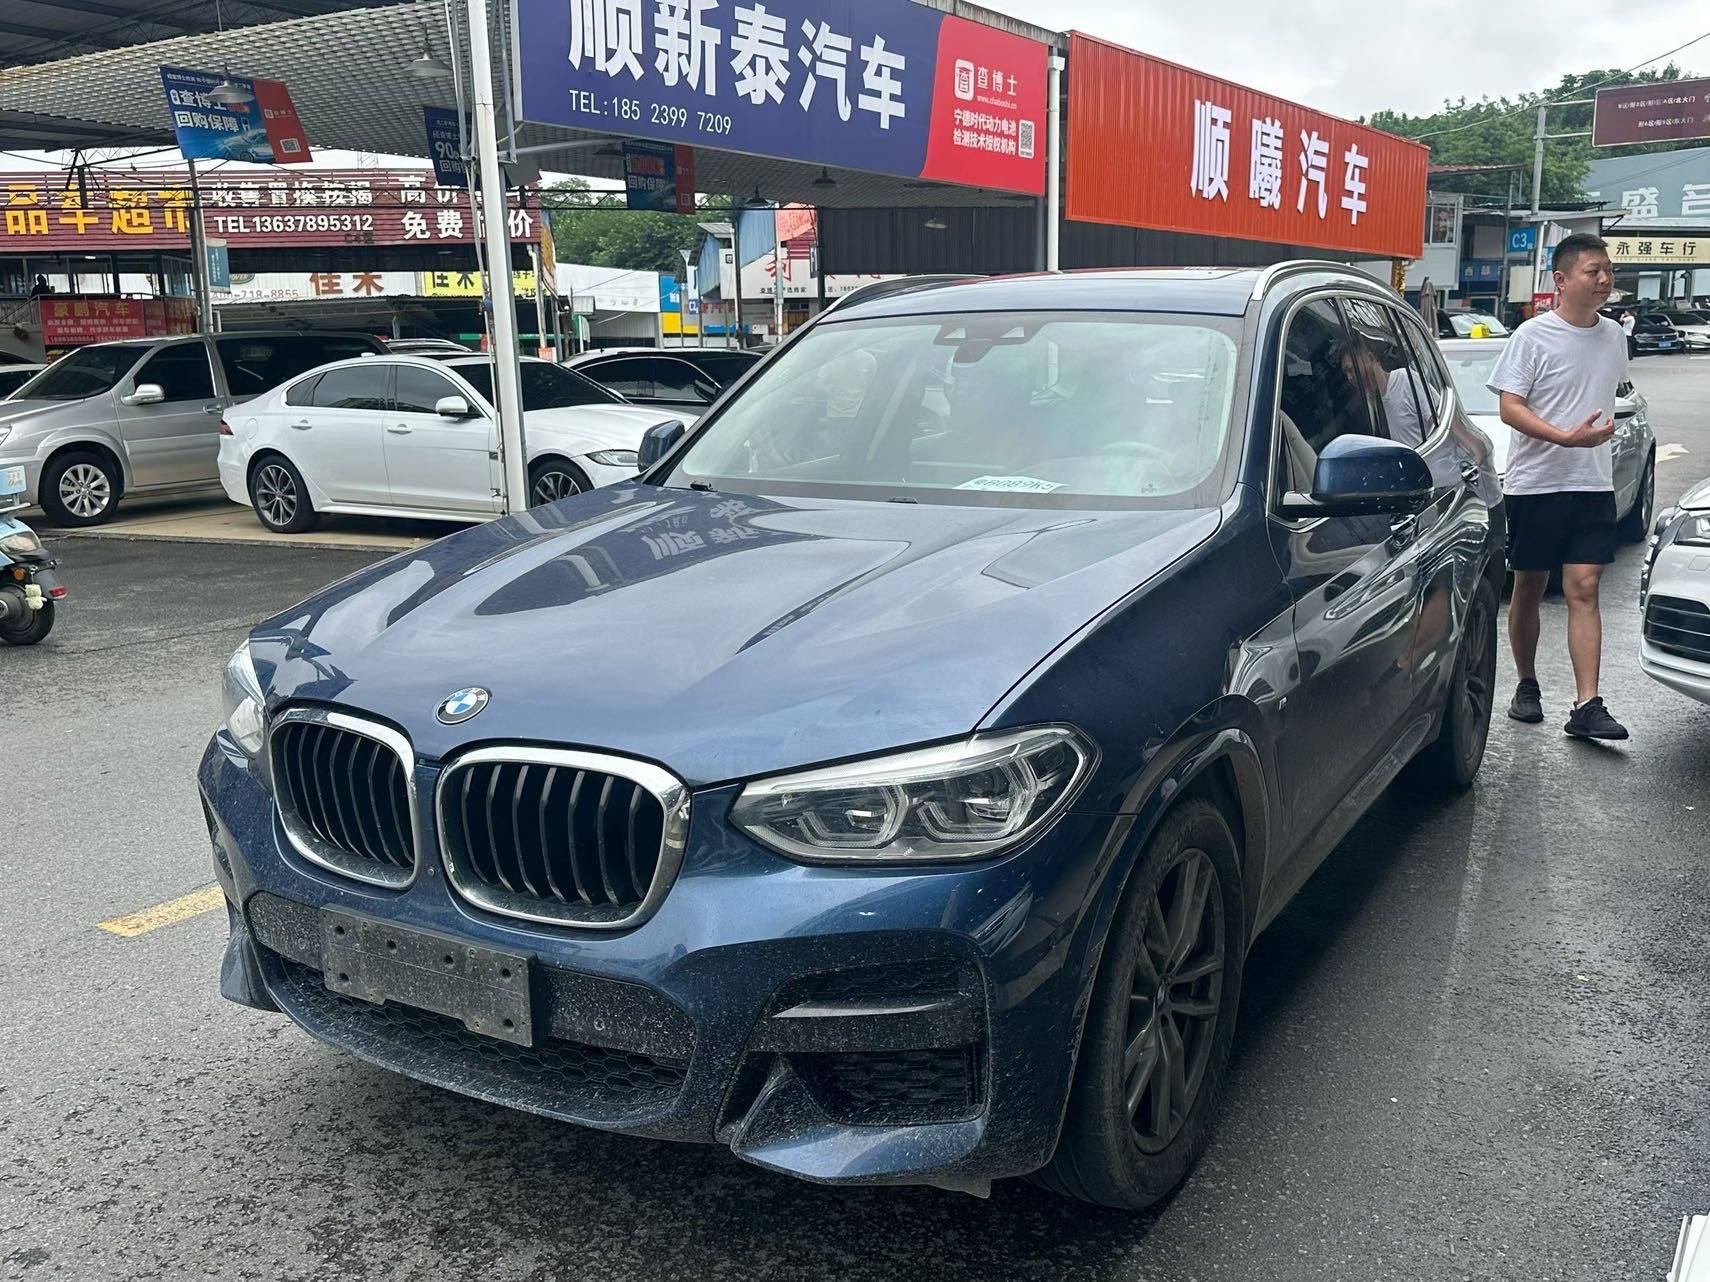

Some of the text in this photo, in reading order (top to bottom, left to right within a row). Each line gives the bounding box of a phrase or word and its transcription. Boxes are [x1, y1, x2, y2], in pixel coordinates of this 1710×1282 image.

[568, 0, 906, 130] 顺新泰汽车
[977, 66, 1018, 96] 查博士
[174, 110, 240, 133] 回购保障
[650, 103, 688, 128] 2399
[697, 111, 732, 135] 7209
[953, 107, 1017, 136] 宁德时代动力电池
[953, 127, 1017, 155] 检测技术授权机构
[1190, 99, 1369, 226] 顺曦汽车
[1616, 241, 1697, 256] 永强车行
